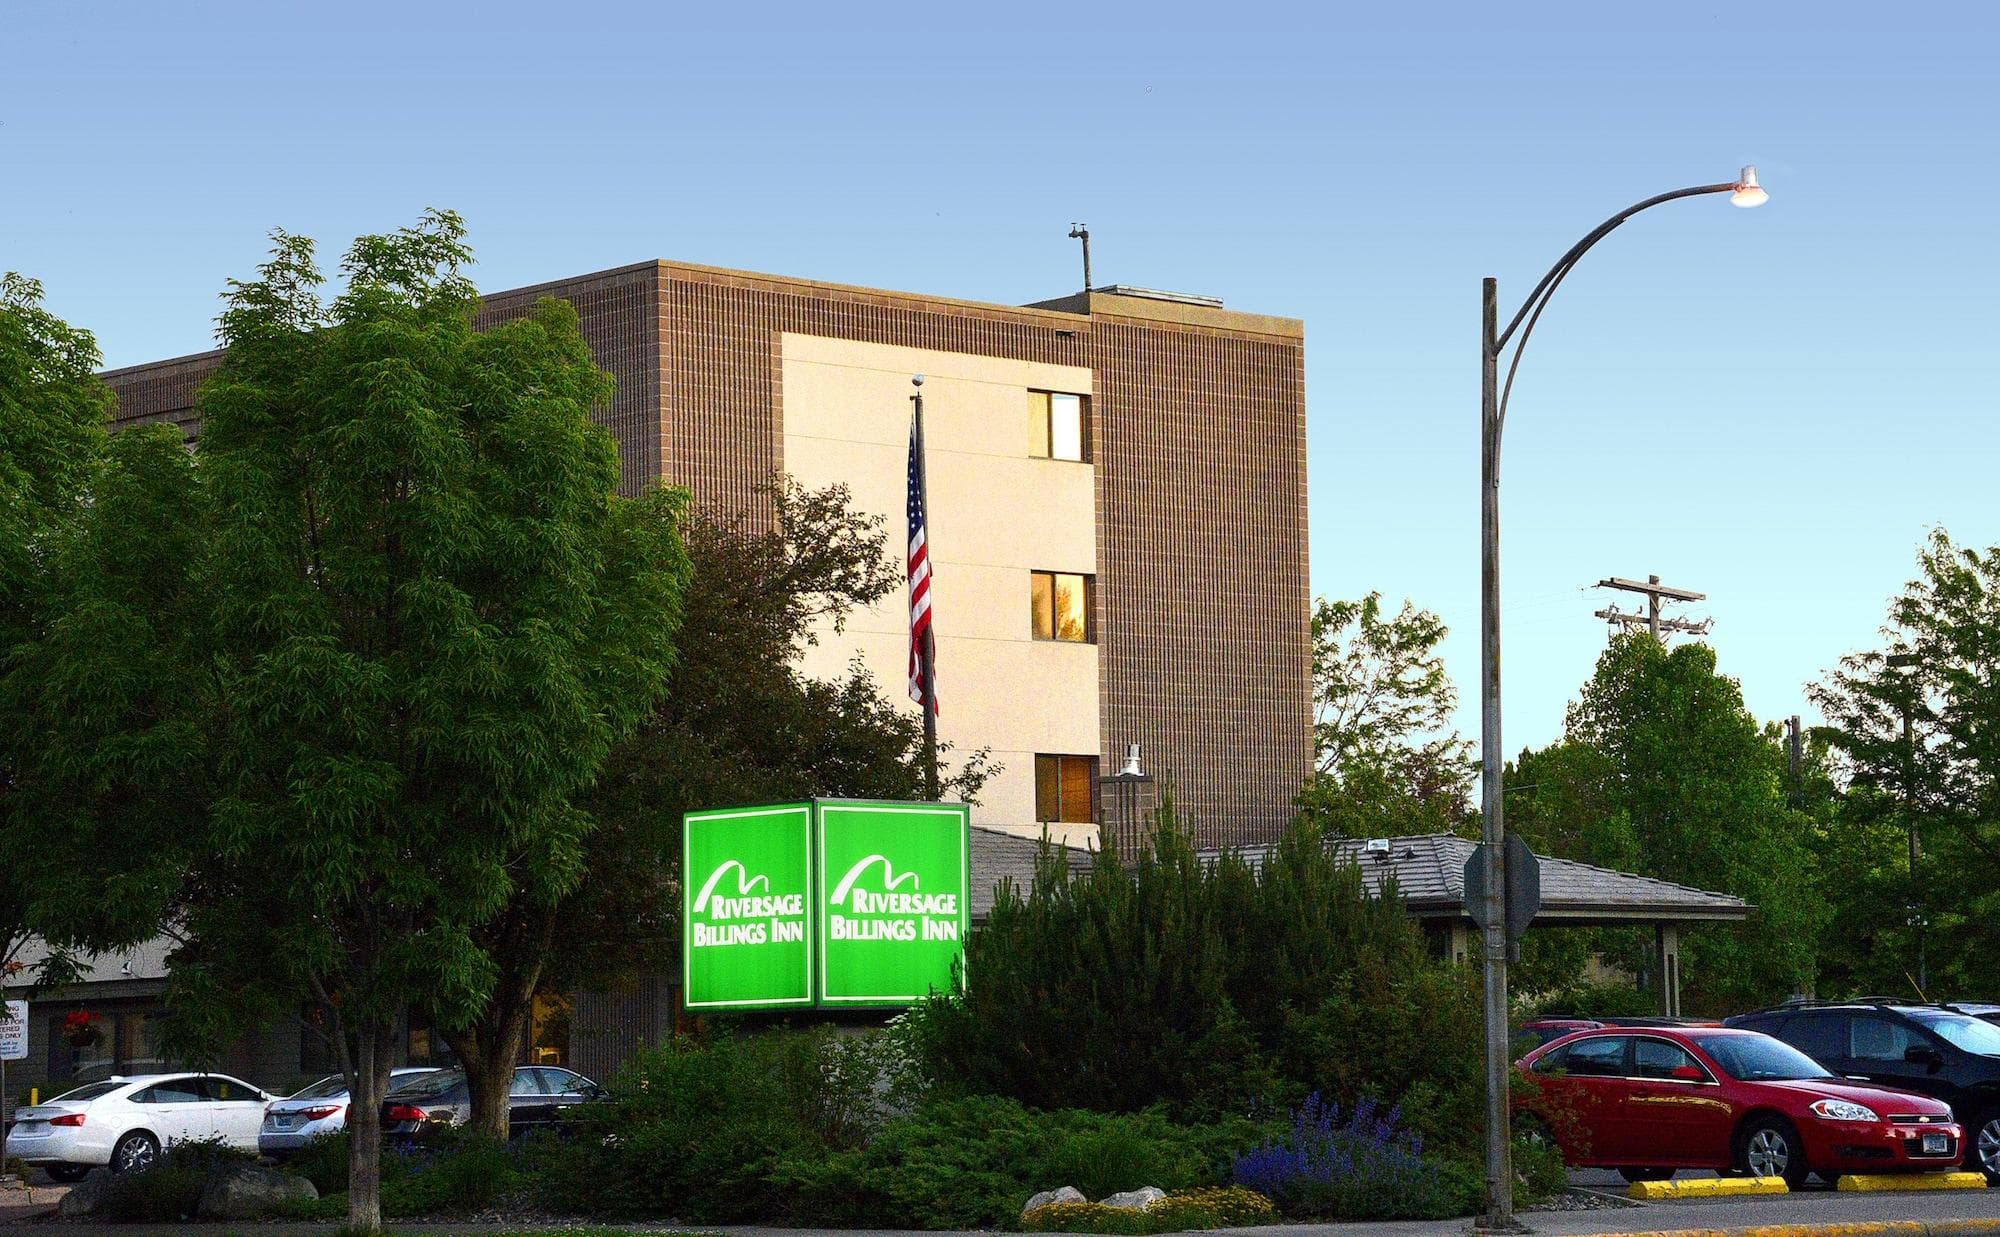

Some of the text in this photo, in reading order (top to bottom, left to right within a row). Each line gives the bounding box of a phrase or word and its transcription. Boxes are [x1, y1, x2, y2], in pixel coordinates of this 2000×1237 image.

[712, 894, 803, 920] RIVERSAGE
[853, 888, 957, 914] RIVERSAGE
[694, 918, 803, 947] BILLINGS INN
[831, 915, 957, 941] BILLINGS INN
